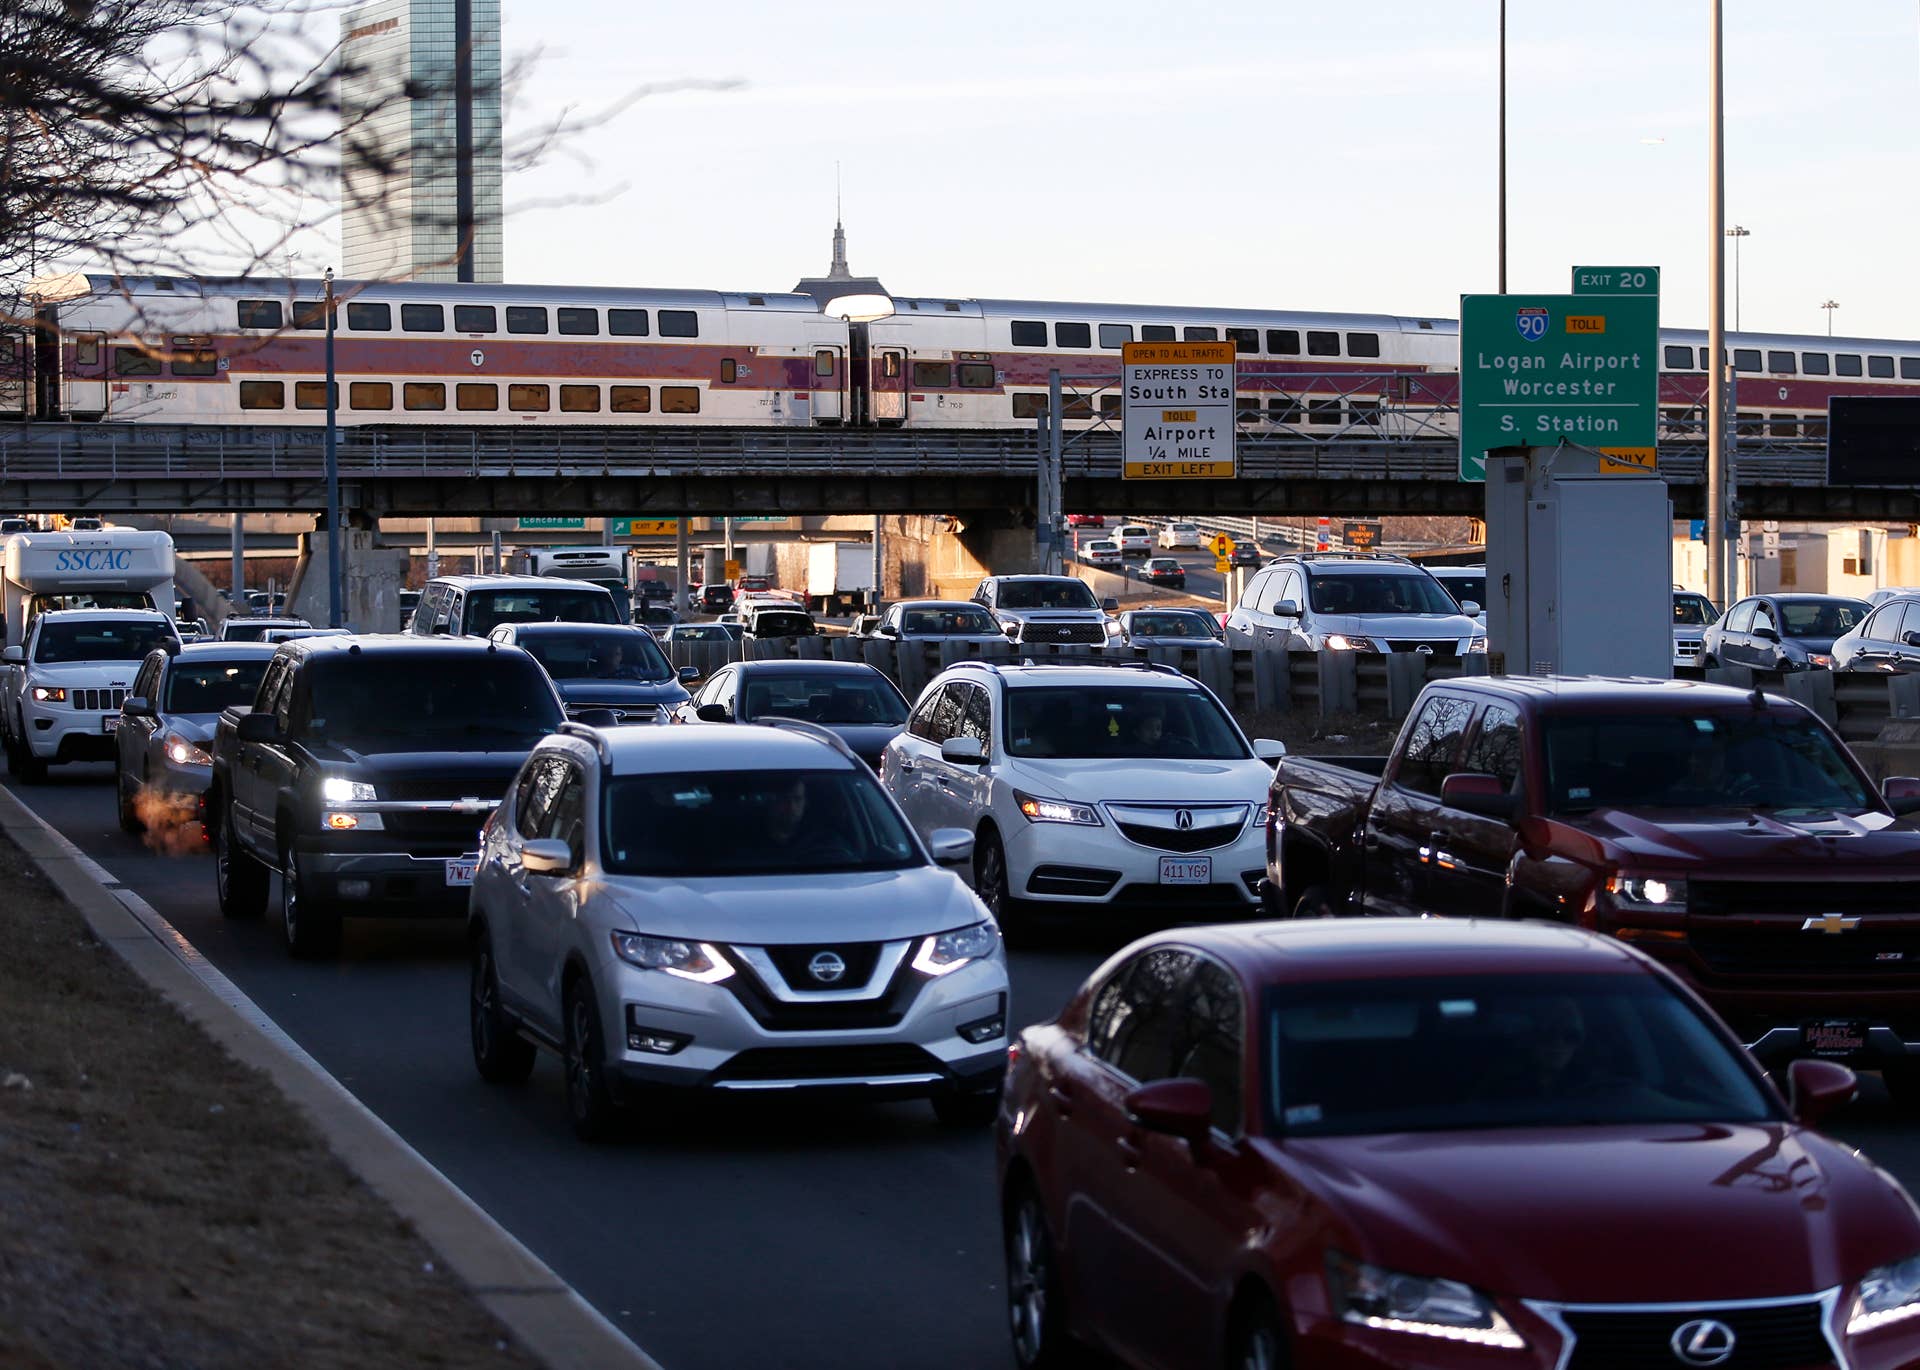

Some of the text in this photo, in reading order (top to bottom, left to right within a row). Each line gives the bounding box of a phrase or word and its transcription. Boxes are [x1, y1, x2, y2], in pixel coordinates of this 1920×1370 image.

[1581, 272, 1646, 288] EXIT 20
[1519, 316, 1545, 335] 90
[1571, 319, 1599, 330] TOLL
[1133, 348, 1225, 359] OPEN TO ALL TRAFFIC
[1478, 352, 1641, 374] Logan Airport
[1134, 368, 1224, 380] EXPRESS TO
[1129, 385, 1229, 399] South Sta
[1503, 378, 1616, 396] Worcester
[1167, 411, 1191, 421] TOLL
[1500, 414, 1619, 432] S. Station
[1144, 426, 1216, 444] Airport
[1149, 446, 1211, 460] 1/4 MILE
[1143, 463, 1215, 475] EXIT LEFT
[56, 549, 132, 571] SSCAC
[449, 866, 471, 881] 7WZ
[1163, 864, 1209, 878] 411 YG9
